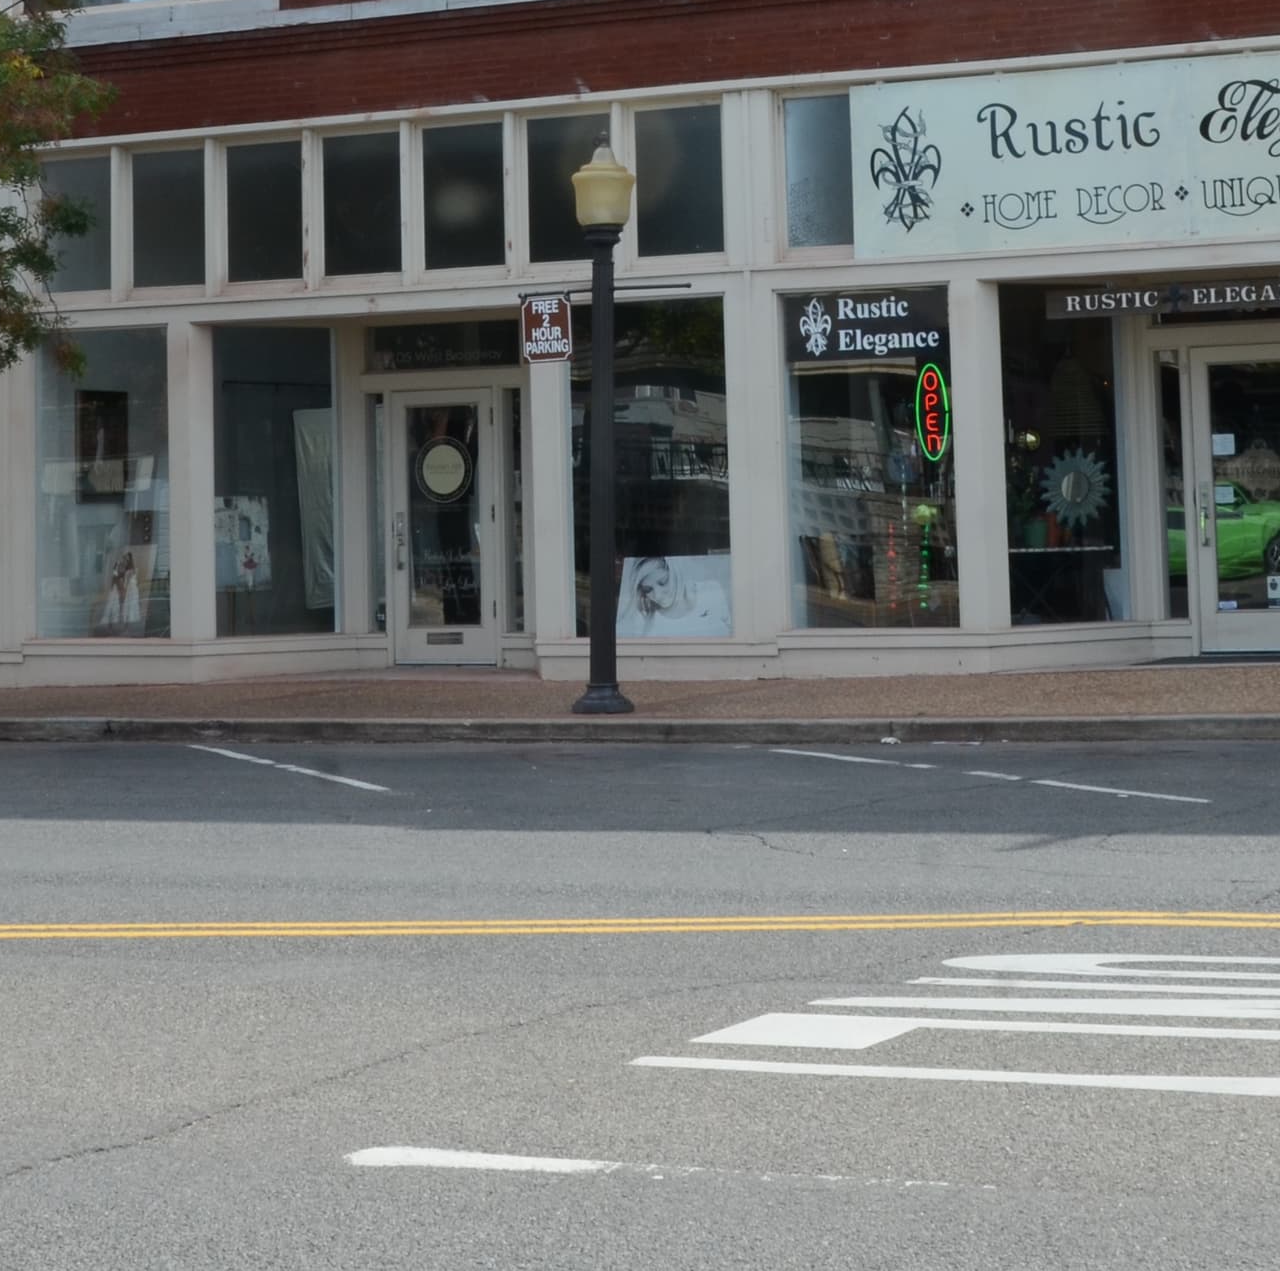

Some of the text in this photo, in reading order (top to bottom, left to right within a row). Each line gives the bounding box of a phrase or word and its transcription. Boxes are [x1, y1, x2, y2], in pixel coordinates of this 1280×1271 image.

[976, 100, 1161, 159] Rustic
[982, 189, 1058, 230] HOME
[1076, 182, 1166, 224] DECOR
[531, 299, 559, 314] FREE
[837, 296, 909, 320] Rustic
[1066, 291, 1159, 312] RUSTIC
[542, 315, 550, 327] 2
[532, 327, 561, 341] HOUR
[838, 329, 939, 356] Elegance
[526, 340, 569, 354] PARKING
[923, 371, 942, 452] OPEN
